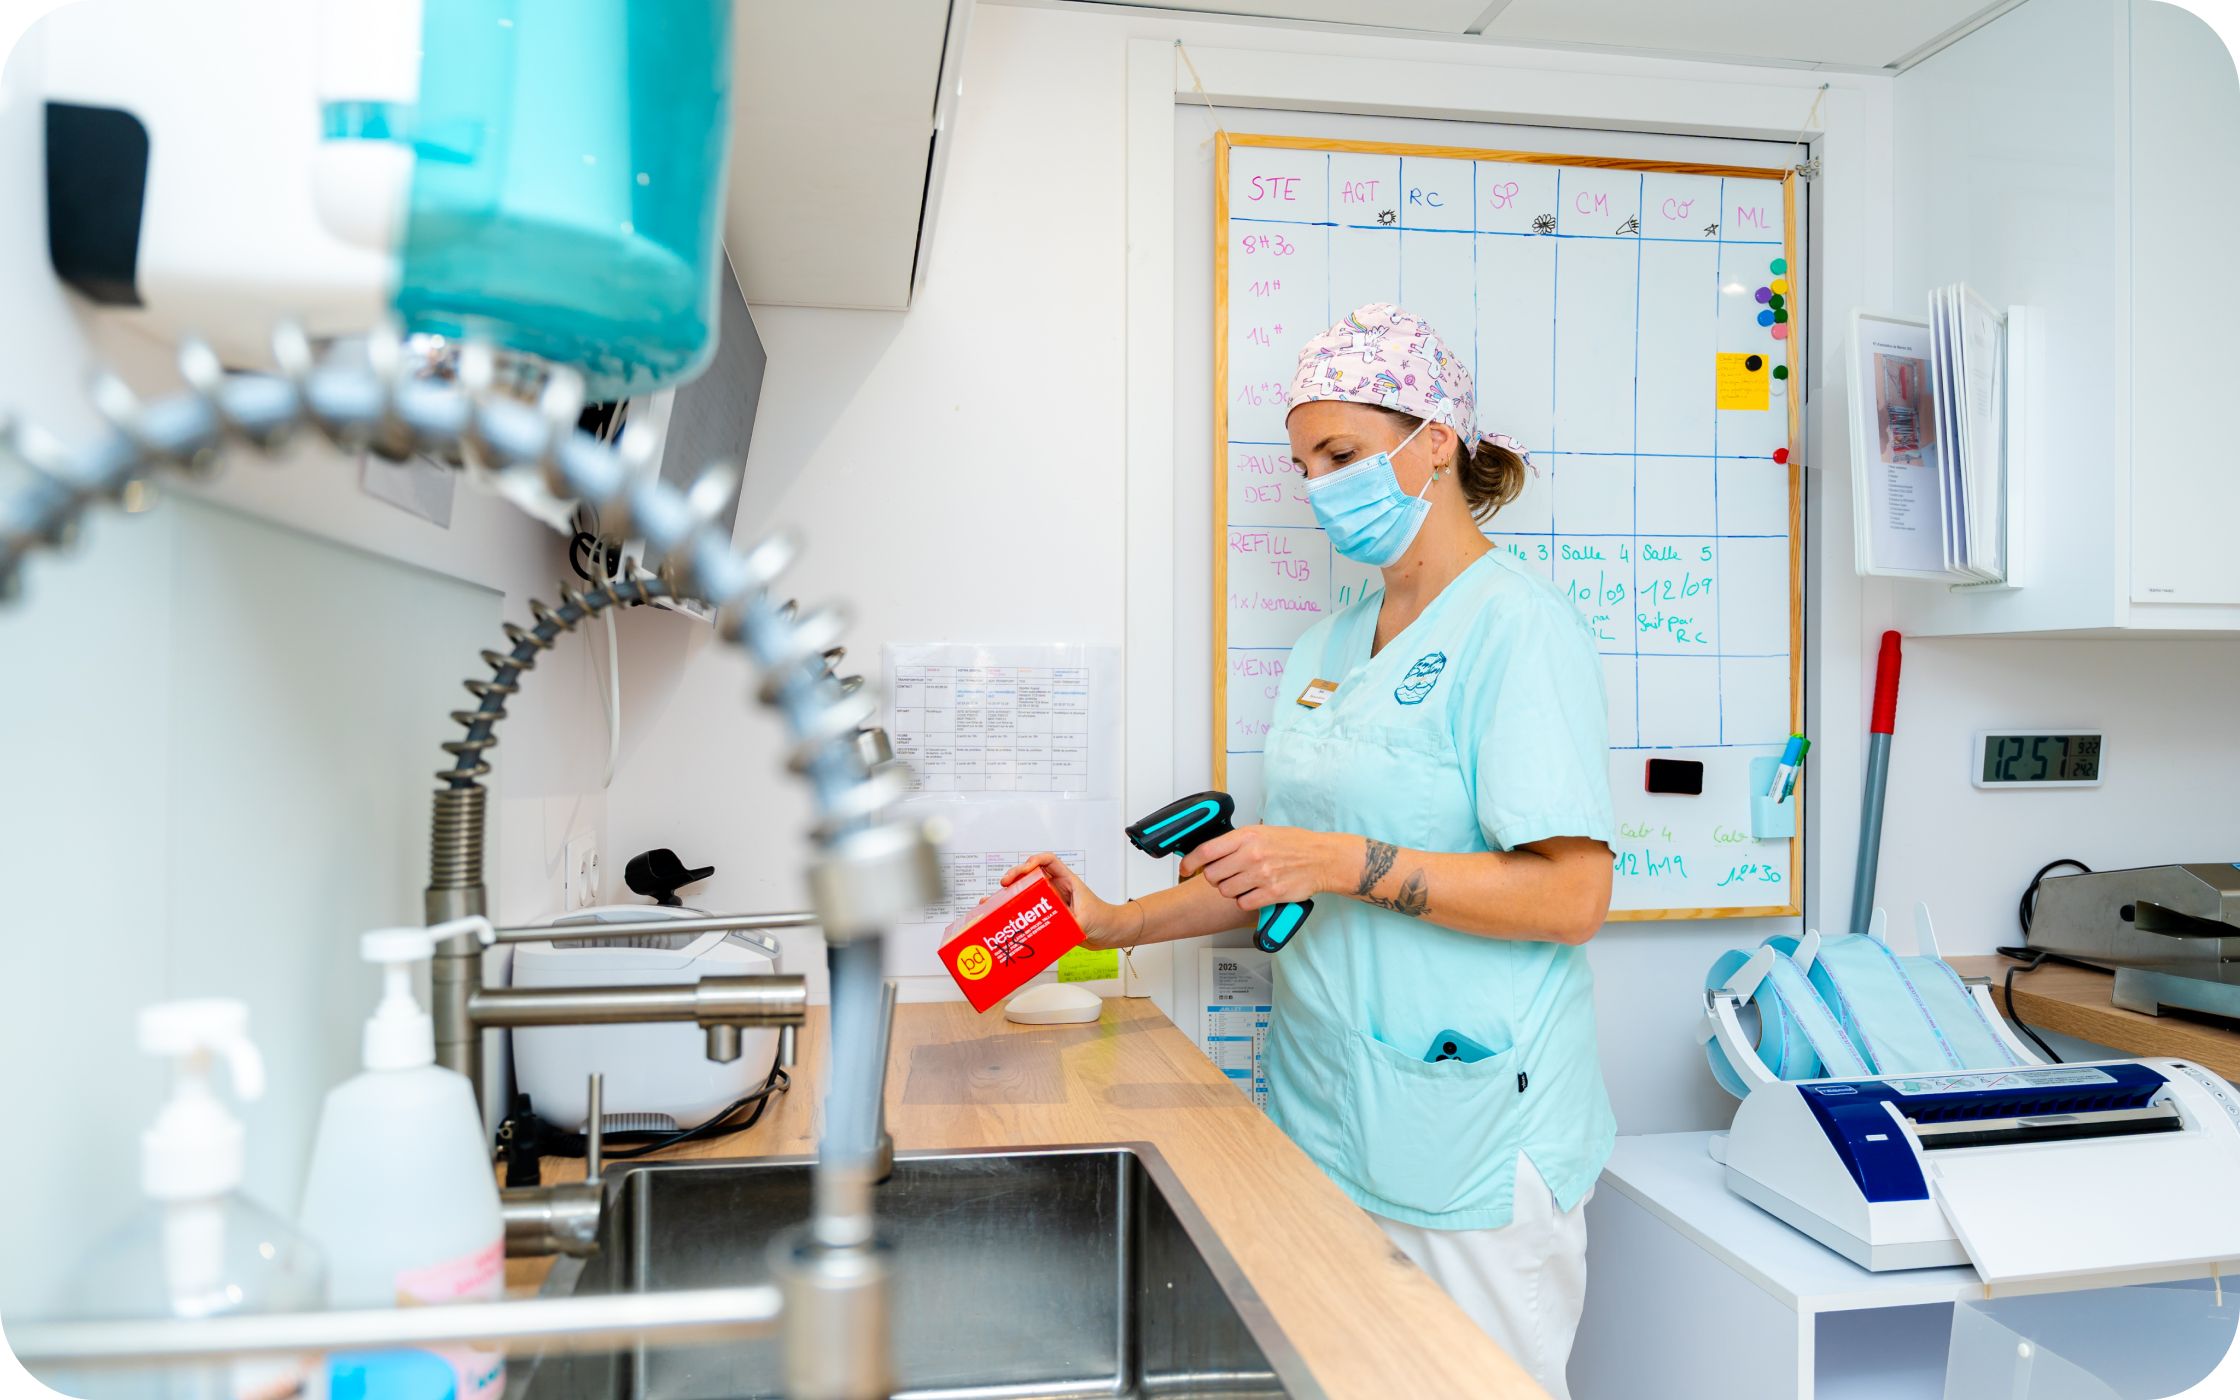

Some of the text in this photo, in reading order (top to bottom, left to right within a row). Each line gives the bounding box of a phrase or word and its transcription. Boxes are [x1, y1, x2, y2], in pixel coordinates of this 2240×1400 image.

[1248, 176, 1301, 201] STE
[1490, 182, 1519, 209] SP
[1576, 192, 1609, 216] CM
[1737, 206, 1771, 229] ML
[1244, 483, 1282, 504] DEJ
[1537, 544, 1548, 561] 3
[1562, 544, 1630, 563] Salle 4
[1643, 544, 1712, 562] Salle 5
[1270, 560, 1310, 582] TUB
[1567, 570, 1625, 607] 10/09
[1640, 572, 1713, 606] 12/09
[1668, 616, 1694, 632] par
[1662, 826, 1672, 842] 4
[983, 896, 1052, 950] bestdent
[960, 947, 985, 971] bd
[994, 930, 1035, 967] XS
